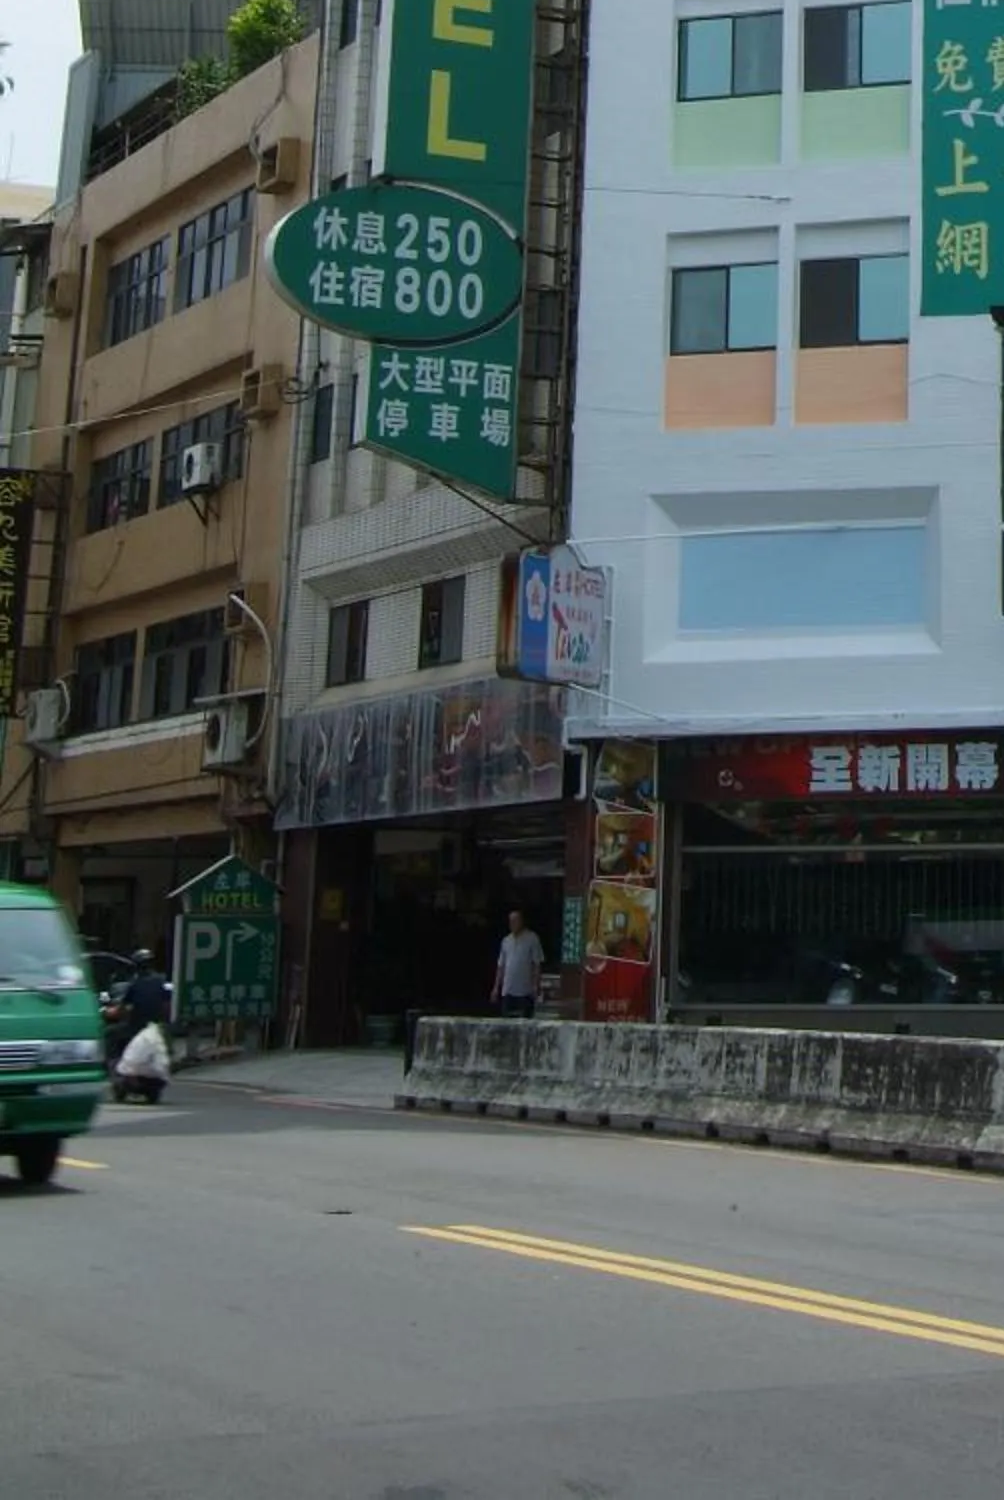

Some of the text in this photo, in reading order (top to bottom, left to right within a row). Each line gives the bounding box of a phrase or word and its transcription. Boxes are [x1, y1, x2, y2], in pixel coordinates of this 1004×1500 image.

[379, 354, 513, 402] 大型平面
[376, 399, 511, 447] 停車場
[202, 891, 263, 910] HOTEL
[186, 921, 221, 981] P
